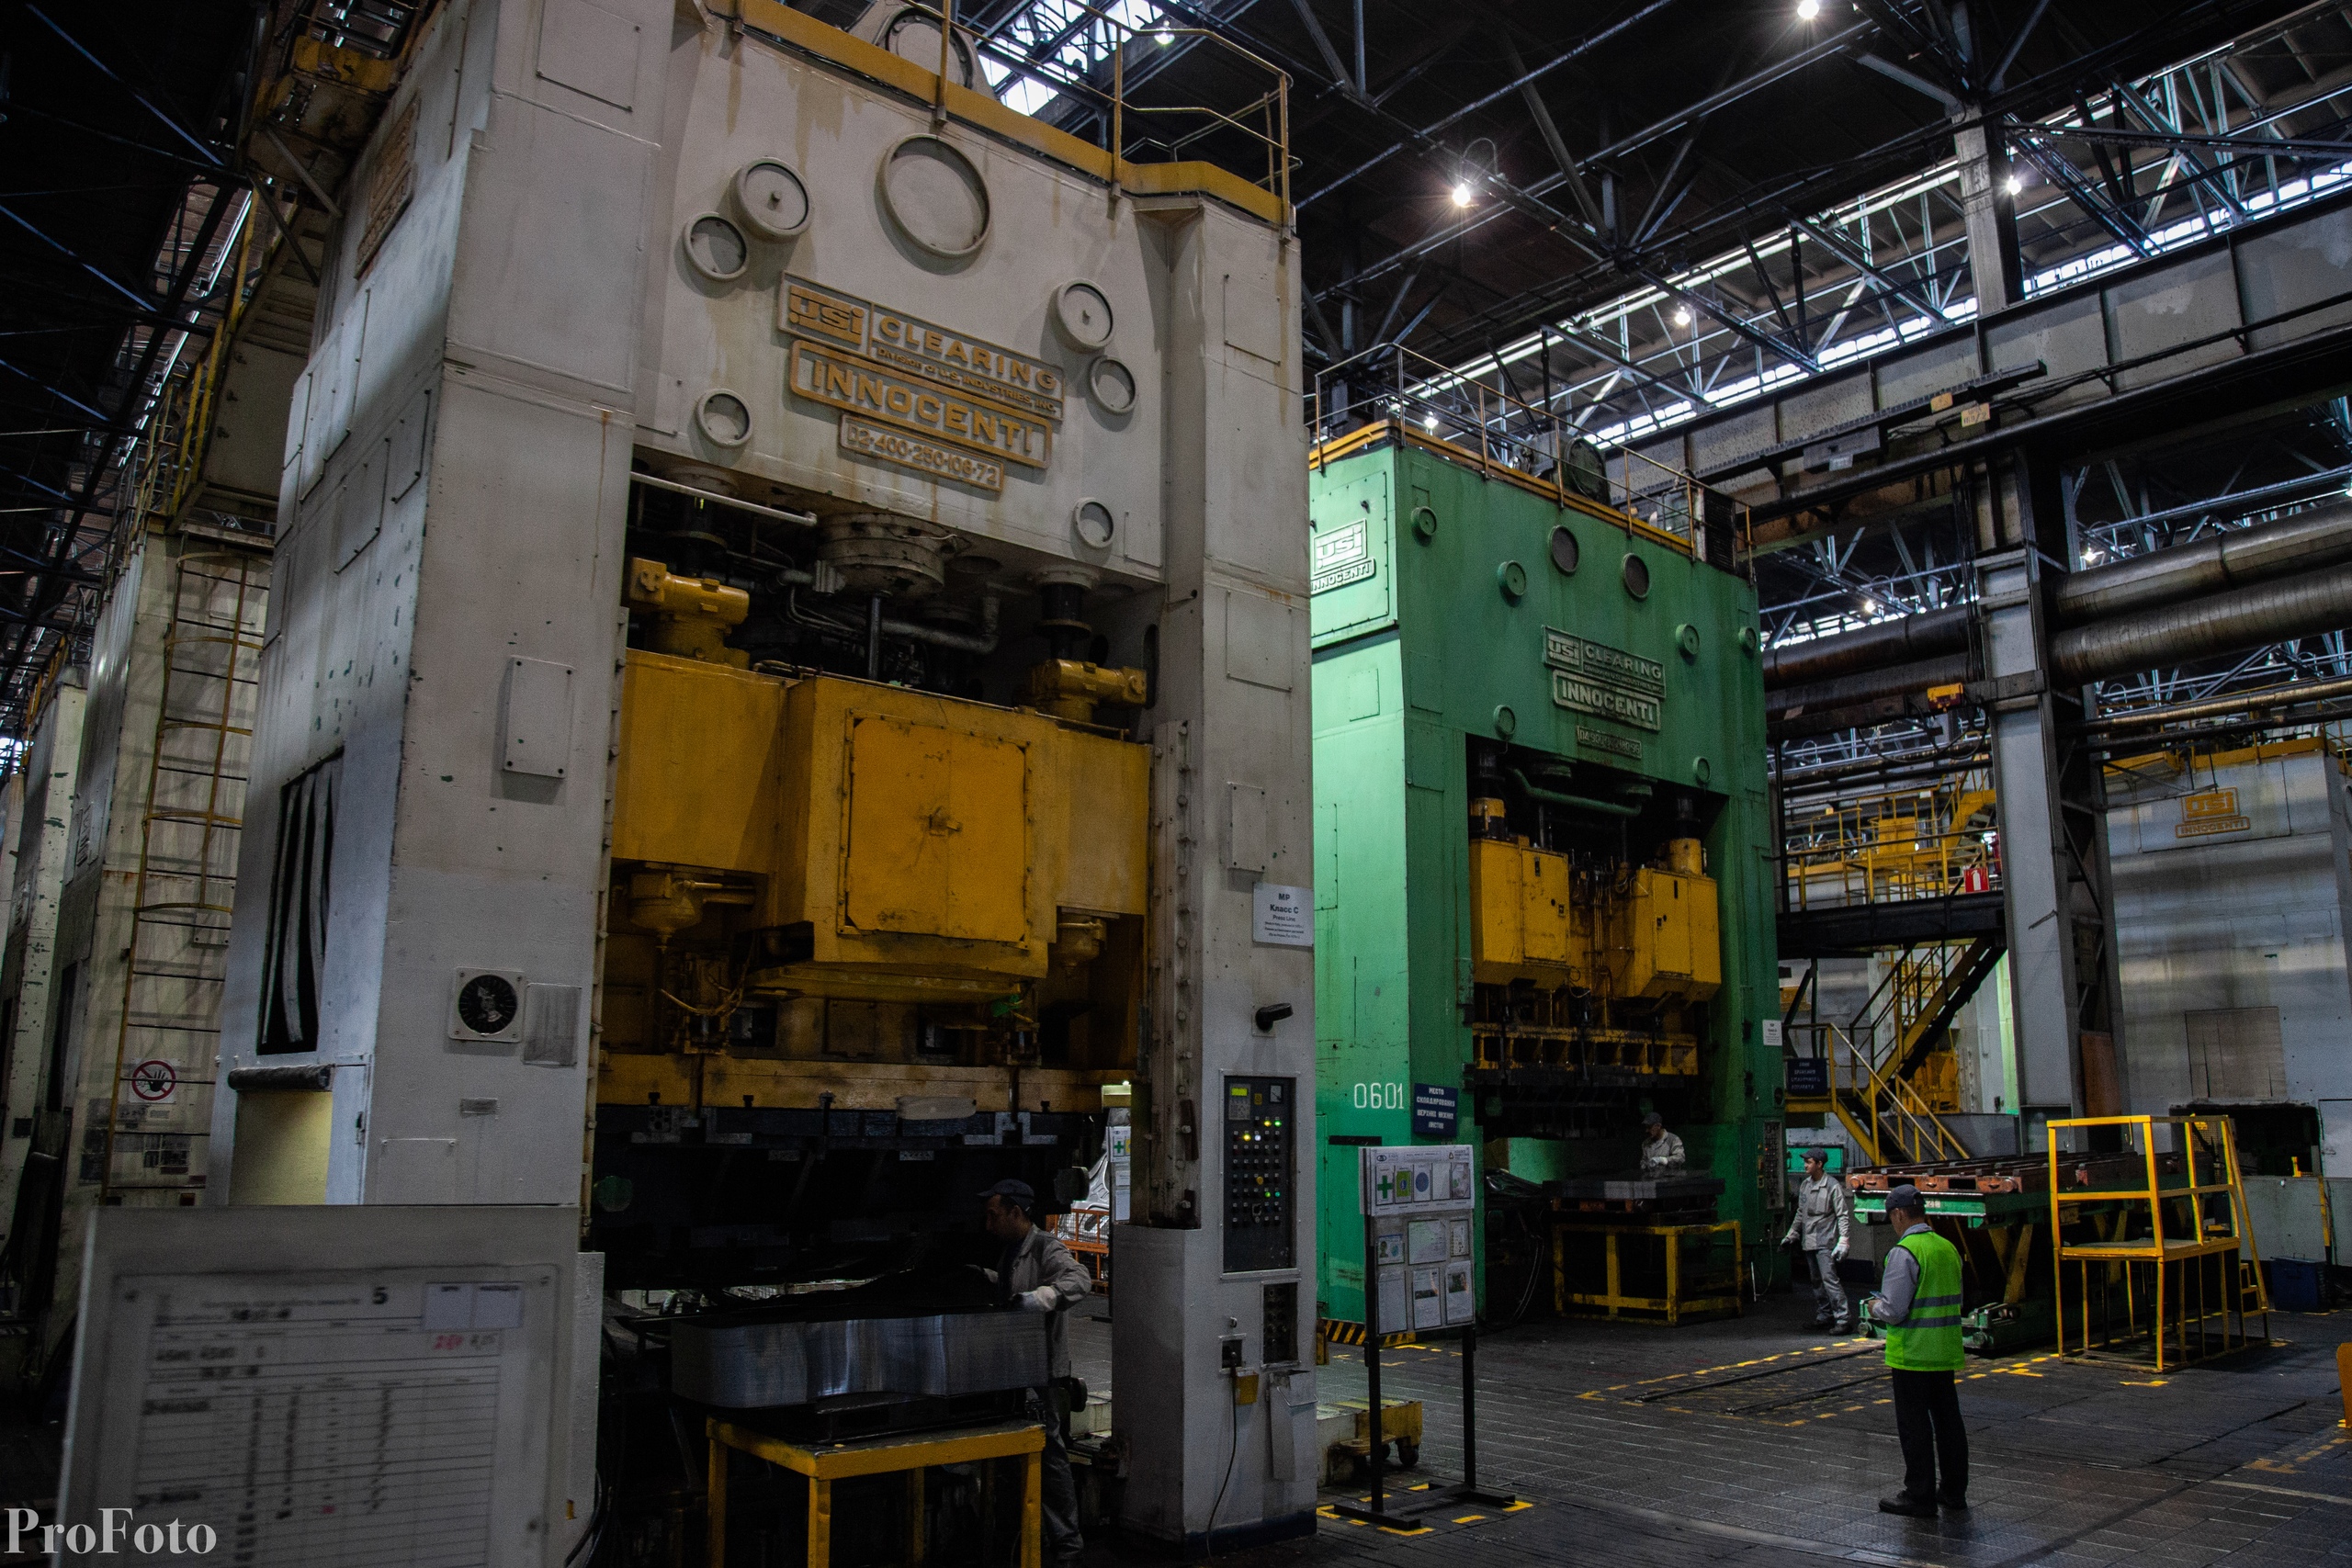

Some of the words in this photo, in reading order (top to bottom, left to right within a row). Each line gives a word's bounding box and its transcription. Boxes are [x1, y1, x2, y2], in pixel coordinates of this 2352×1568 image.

[879, 315, 1057, 389] CLEARING
[812, 358, 1035, 453] INNOCENTI
[1035, 399, 1057, 413] INC.
[1585, 645, 1662, 680] CLEARING
[1562, 679, 1654, 722] INNOCENTI
[1270, 904, 1292, 913] Класс
[1354, 1083, 1404, 1110] 0601
[1429, 1087, 1444, 1095] МЕСТО
[373, 1286, 388, 1304] 5
